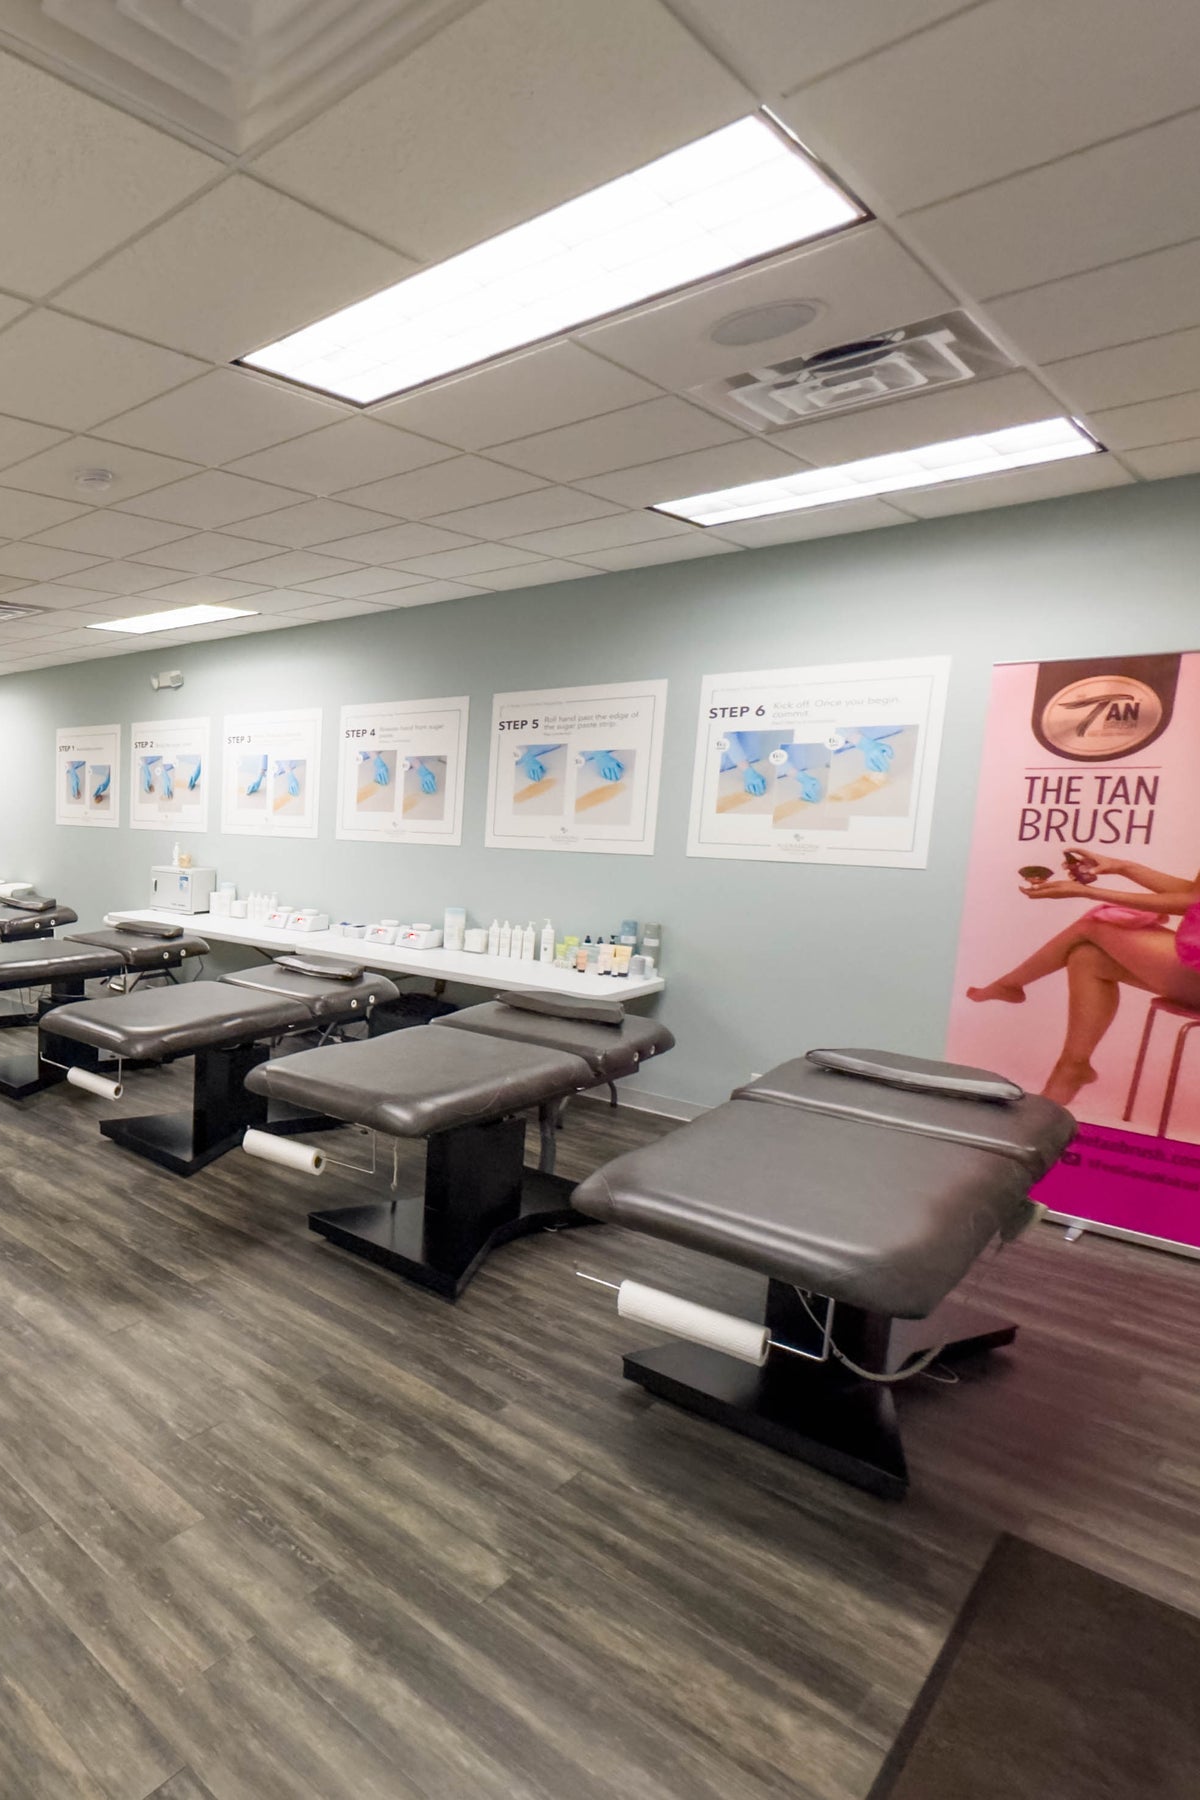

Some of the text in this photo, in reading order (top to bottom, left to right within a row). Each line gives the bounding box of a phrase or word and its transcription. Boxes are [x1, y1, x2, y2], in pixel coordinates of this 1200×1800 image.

[814, 699, 842, 708] Once
[708, 705, 766, 719] STEP 6
[498, 719, 539, 731] STEP 5
[345, 729, 367, 738] STEP
[369, 728, 376, 737] 4
[134, 741, 148, 749] STEP
[227, 736, 245, 744] STEP
[246, 735, 251, 743] 3
[1024, 776, 1160, 805] THE TAN
[1018, 808, 1155, 845] BRUSH
